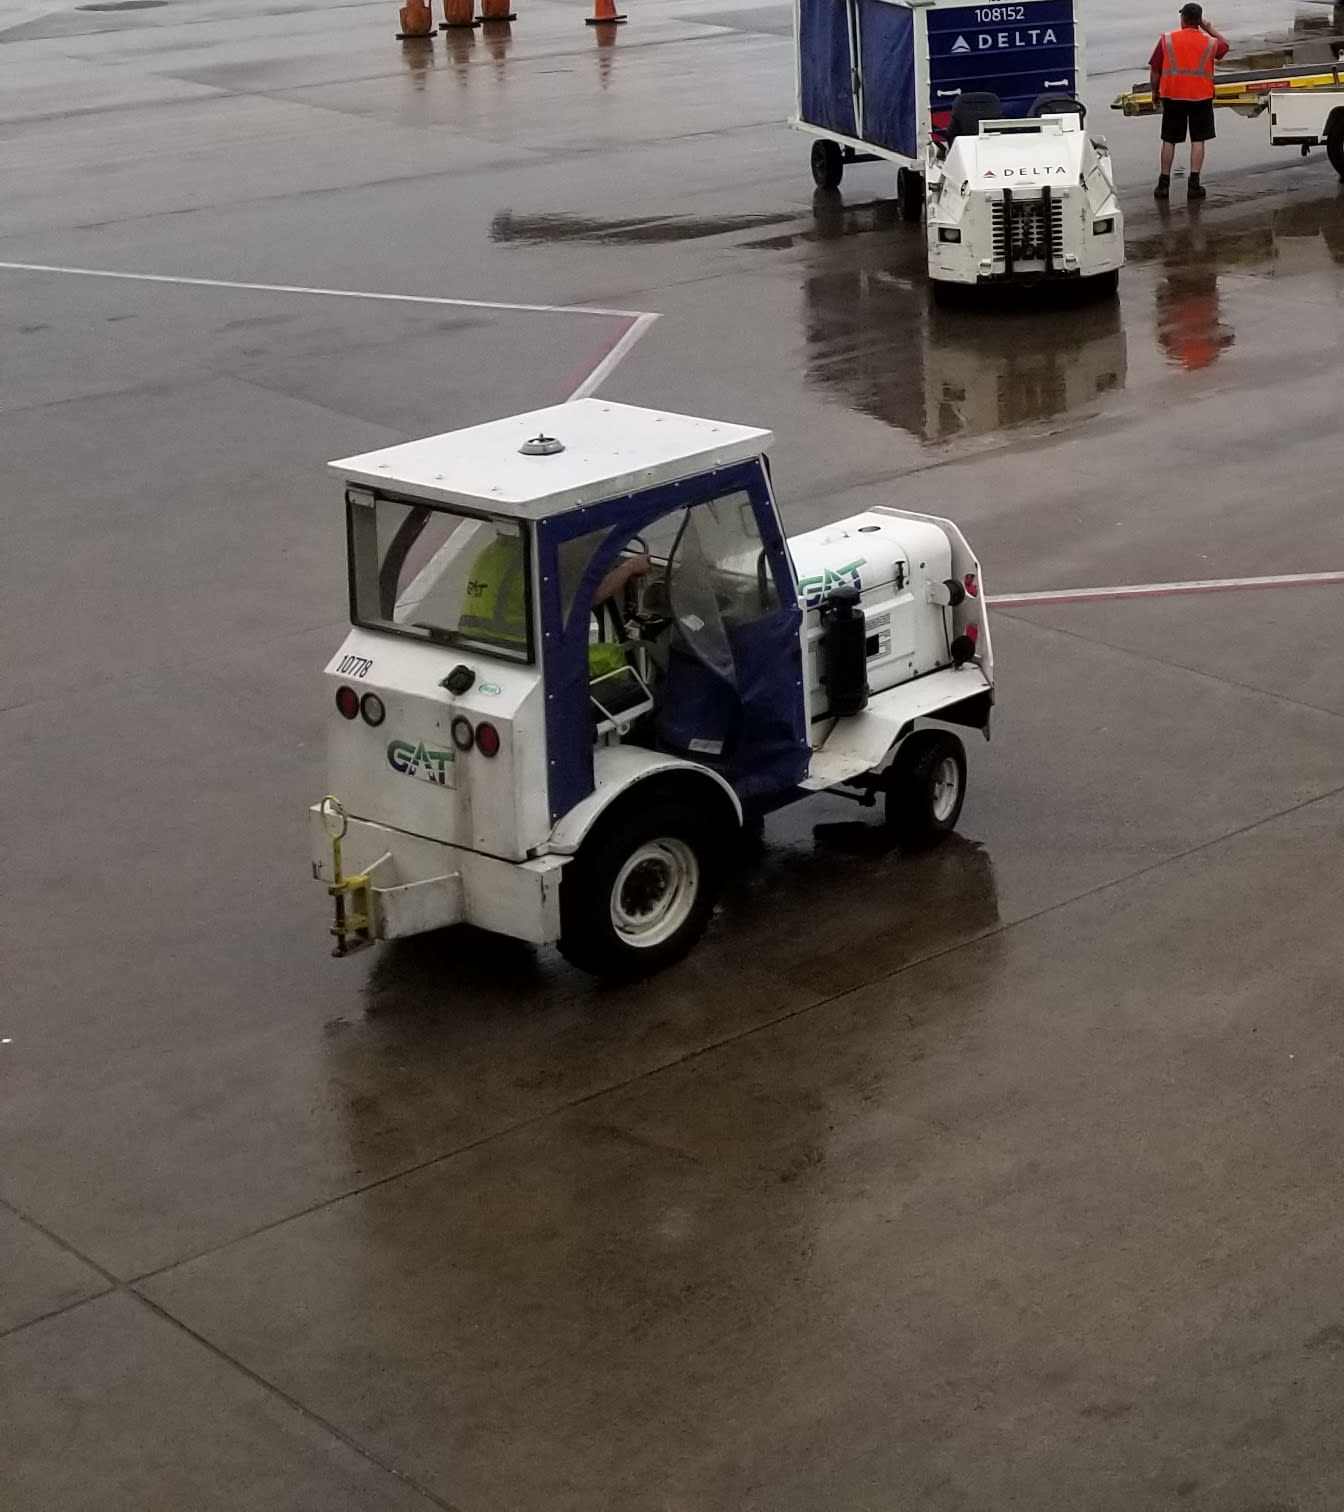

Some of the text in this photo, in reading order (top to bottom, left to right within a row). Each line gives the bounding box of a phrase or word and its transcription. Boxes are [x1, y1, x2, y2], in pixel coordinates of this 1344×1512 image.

[974, 6, 1025, 23] 108152
[978, 28, 1057, 49] DELTA
[1003, 166, 1066, 177] DELTA
[335, 654, 374, 679] 10778
[387, 740, 456, 785] GAT
